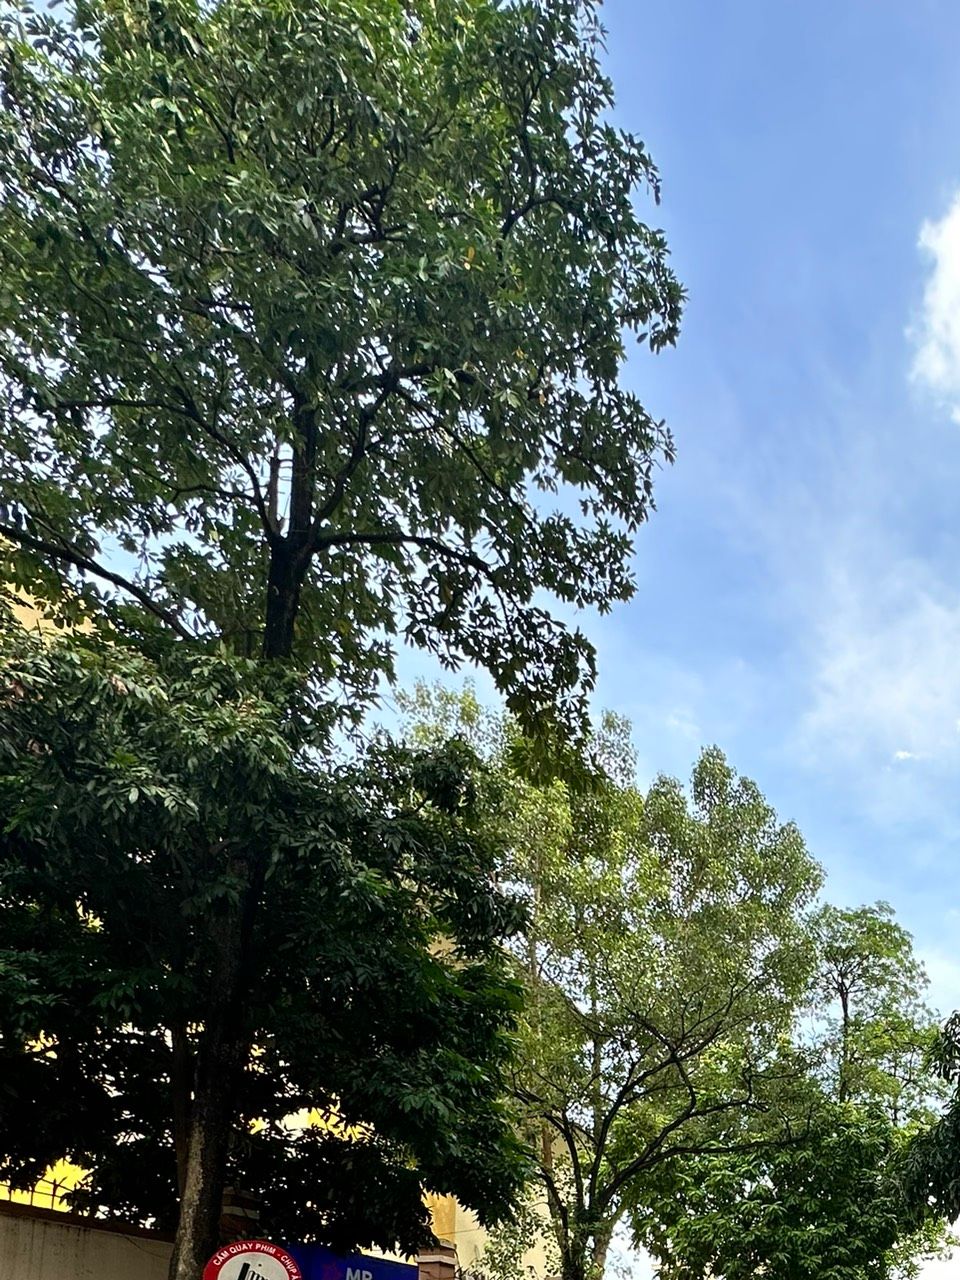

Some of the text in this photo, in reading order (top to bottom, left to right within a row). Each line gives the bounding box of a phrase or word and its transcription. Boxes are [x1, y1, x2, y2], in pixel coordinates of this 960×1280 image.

[229, 1243, 253, 1254] QUAY
[255, 1243, 277, 1255] PHIM
[280, 1255, 297, 1275] CHỤP
